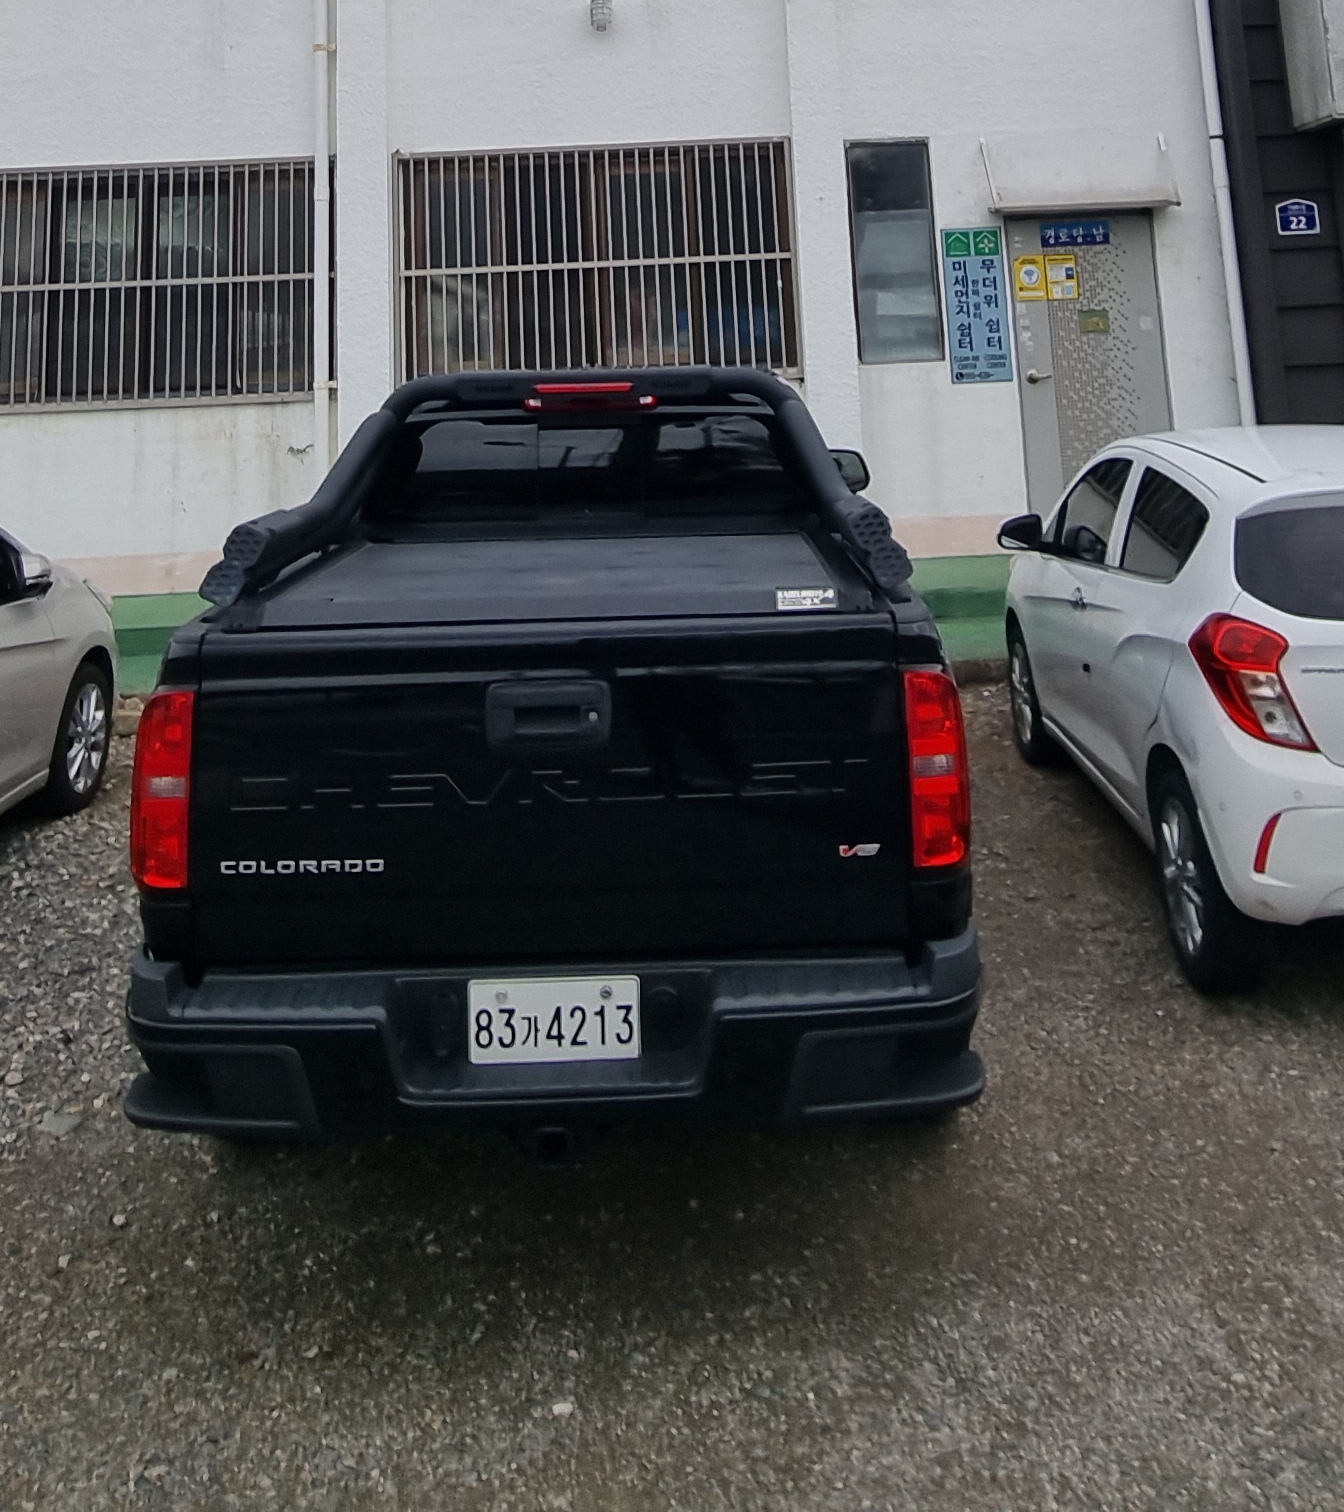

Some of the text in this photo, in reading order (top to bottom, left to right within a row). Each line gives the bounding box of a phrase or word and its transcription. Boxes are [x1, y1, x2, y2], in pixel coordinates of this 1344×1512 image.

[1289, 216, 1307, 229] 22
[951, 259, 974, 352] 미세먼지 쉼터
[980, 258, 1003, 351] 무더위 쉼터
[219, 859, 385, 875] COLORADO
